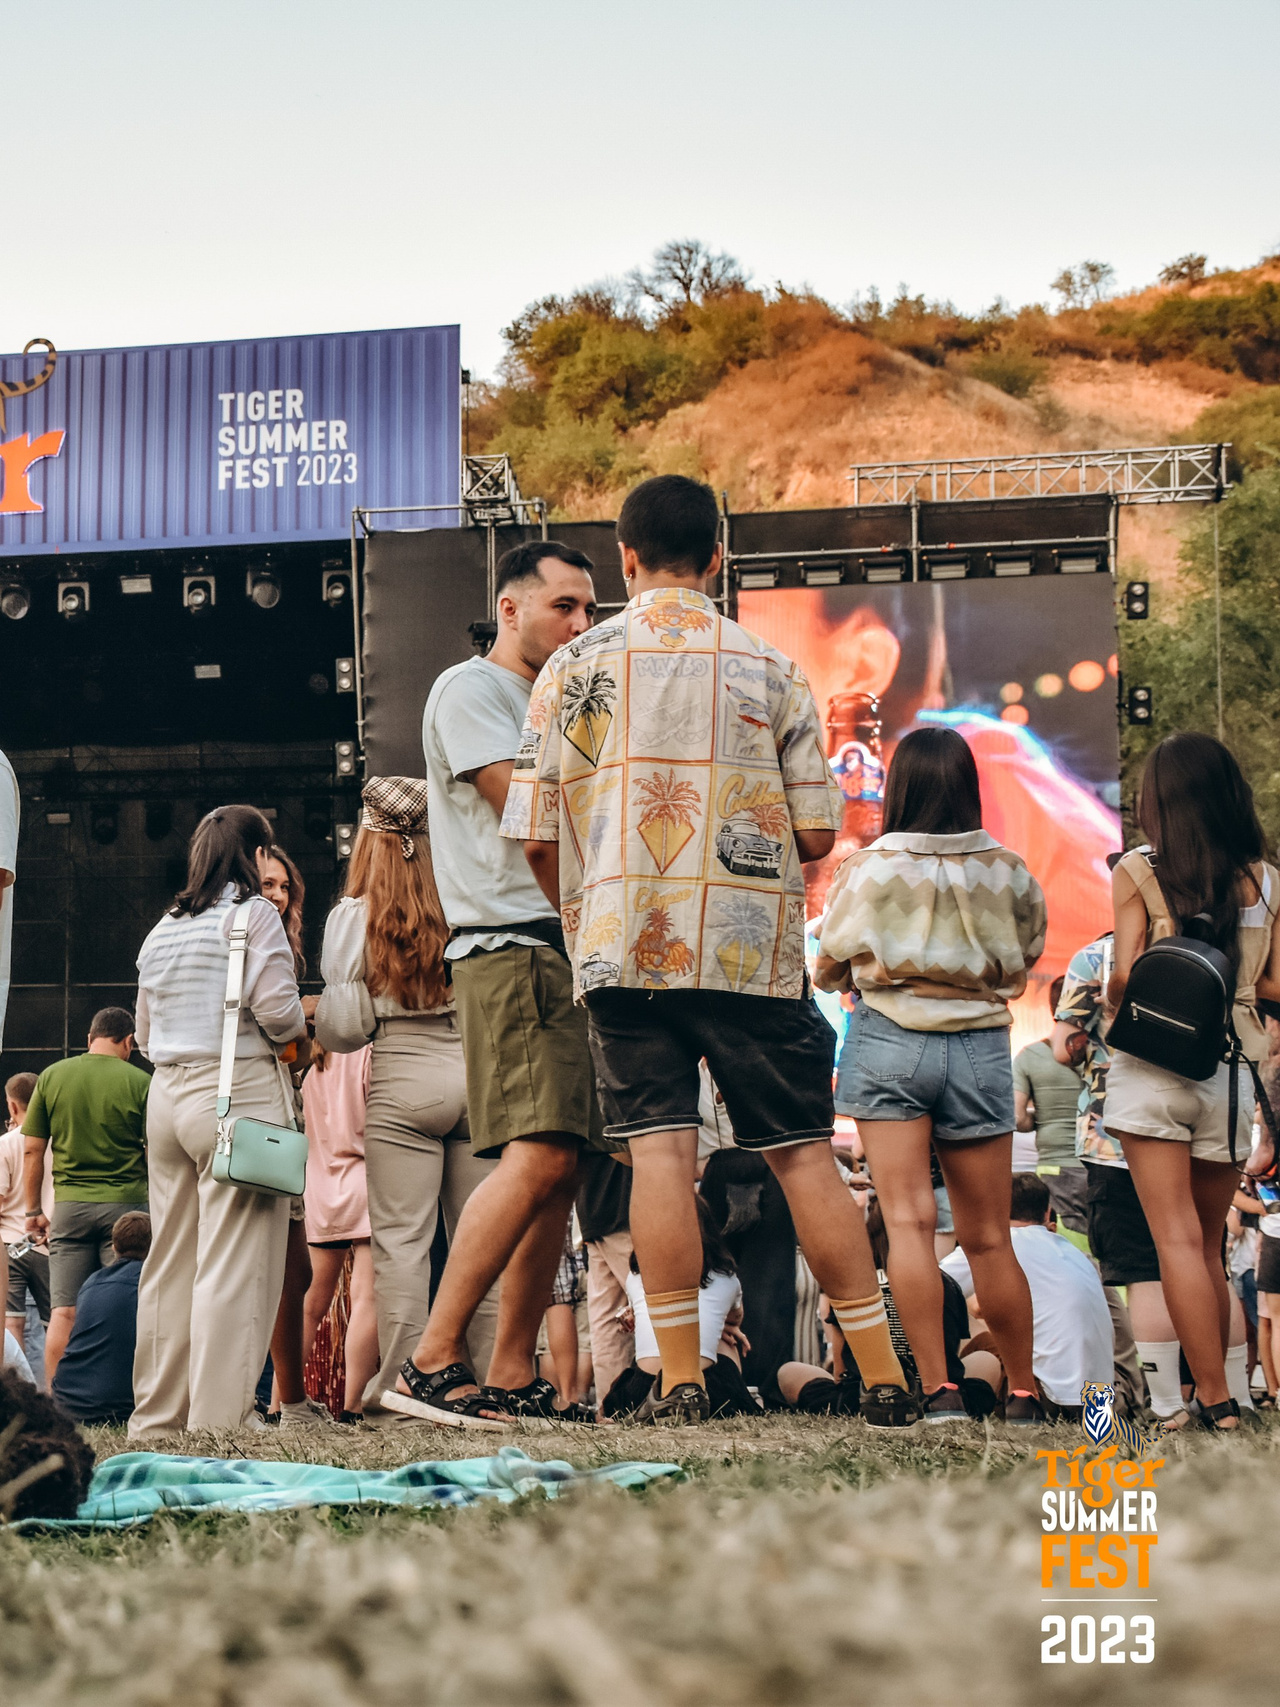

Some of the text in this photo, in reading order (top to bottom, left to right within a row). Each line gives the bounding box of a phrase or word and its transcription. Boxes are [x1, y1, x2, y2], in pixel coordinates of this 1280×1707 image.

[218, 389, 304, 423] TIGER
[218, 420, 348, 457] SUMMER
[218, 453, 358, 490] FEST 2023
[633, 654, 708, 679] MAMBO
